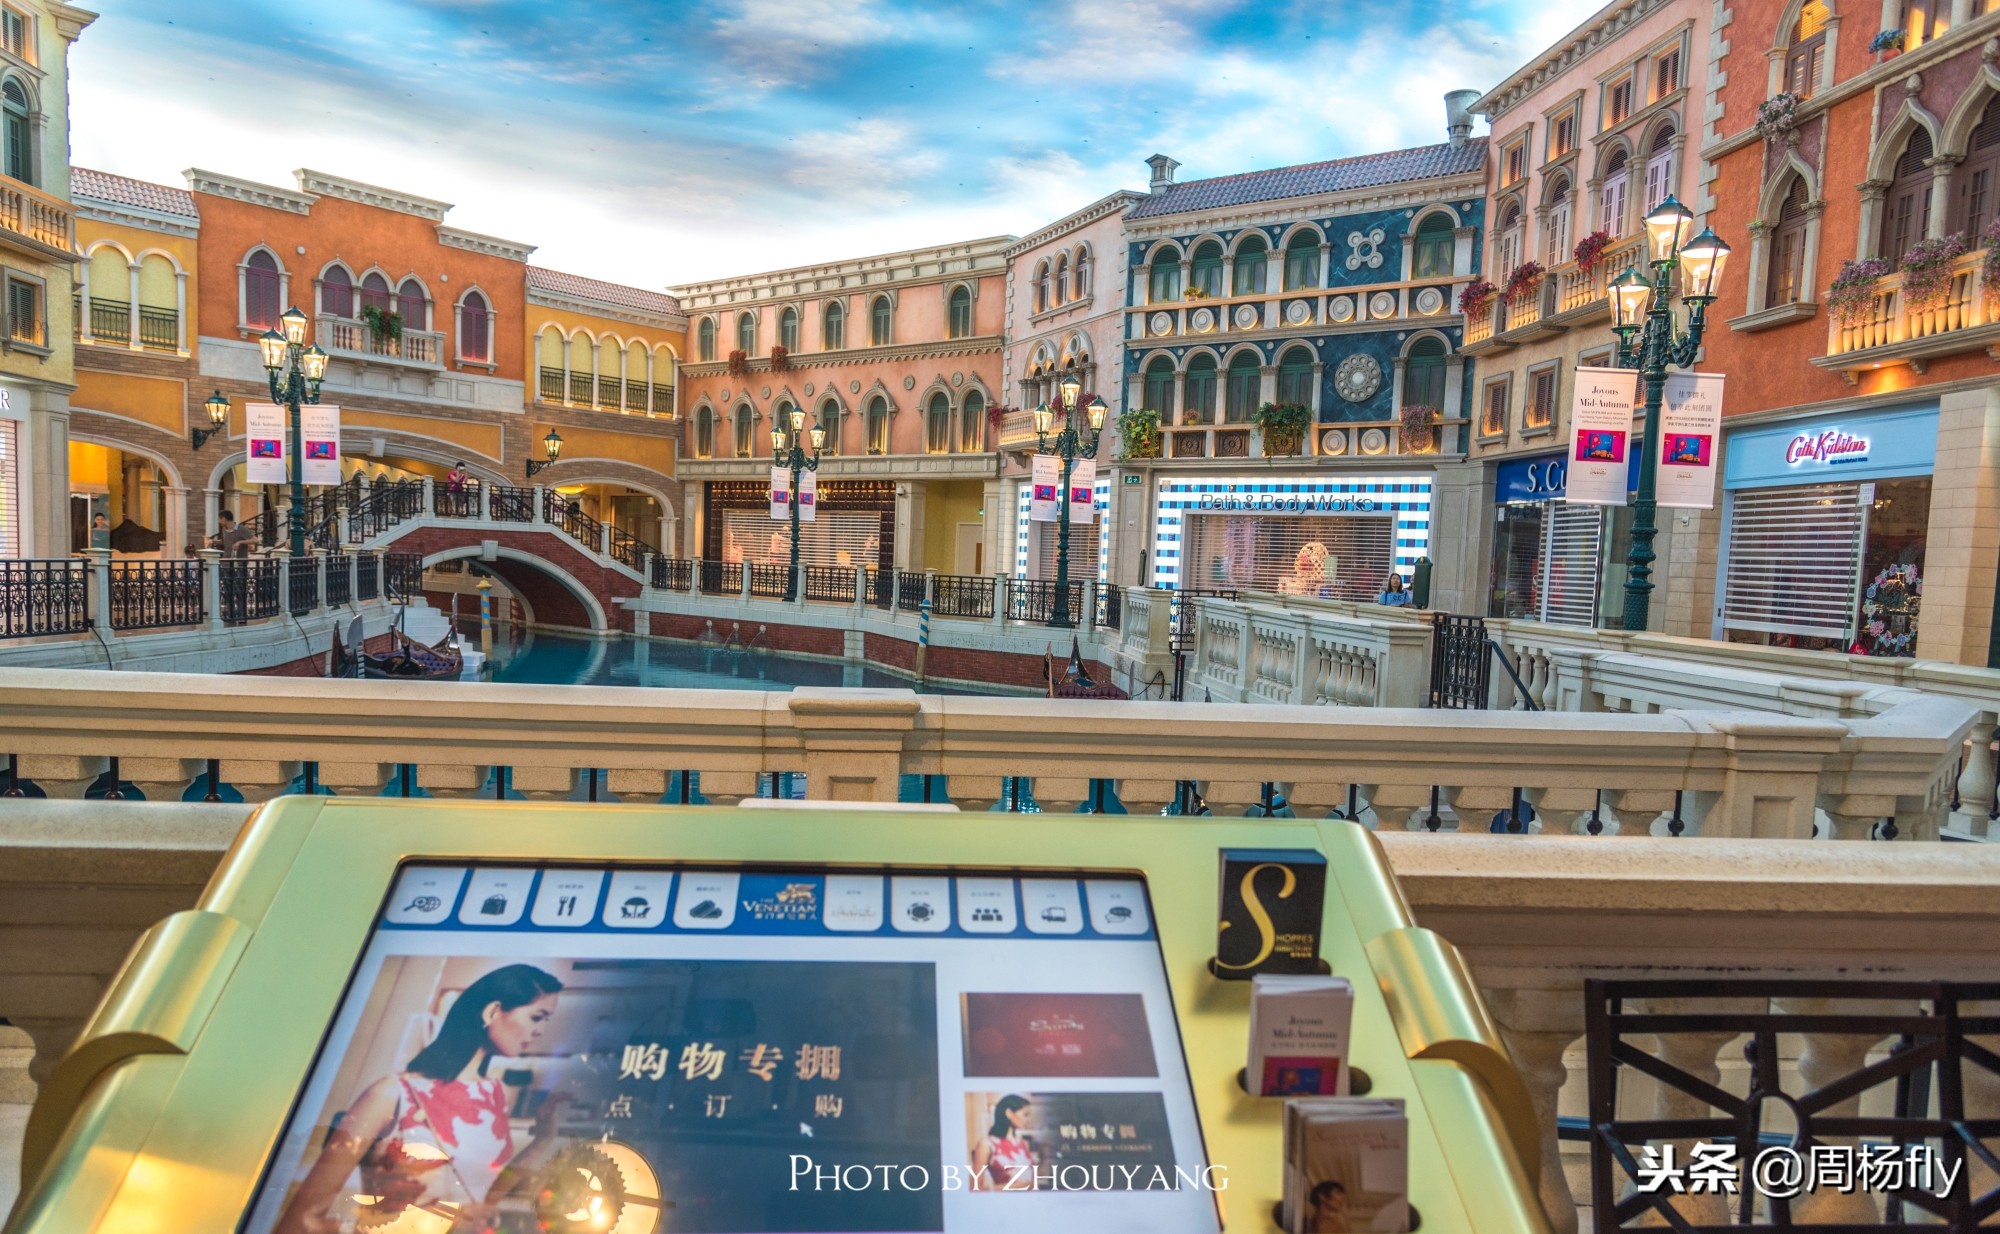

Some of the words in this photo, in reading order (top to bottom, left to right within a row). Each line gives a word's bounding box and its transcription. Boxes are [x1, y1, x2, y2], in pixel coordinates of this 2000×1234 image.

[1592, 385, 1619, 397] Joyous
[1580, 398, 1629, 409] Mid-Autumn
[1786, 436, 1815, 464] Cath
[1812, 431, 1866, 461] Kidston
[1201, 494, 1241, 511] Bath
[1245, 494, 1257, 511] &
[1260, 494, 1309, 514] Body
[1311, 494, 1374, 512] Works
[742, 900, 817, 913] VENETIAN
[618, 1042, 842, 1081] 购物专拥
